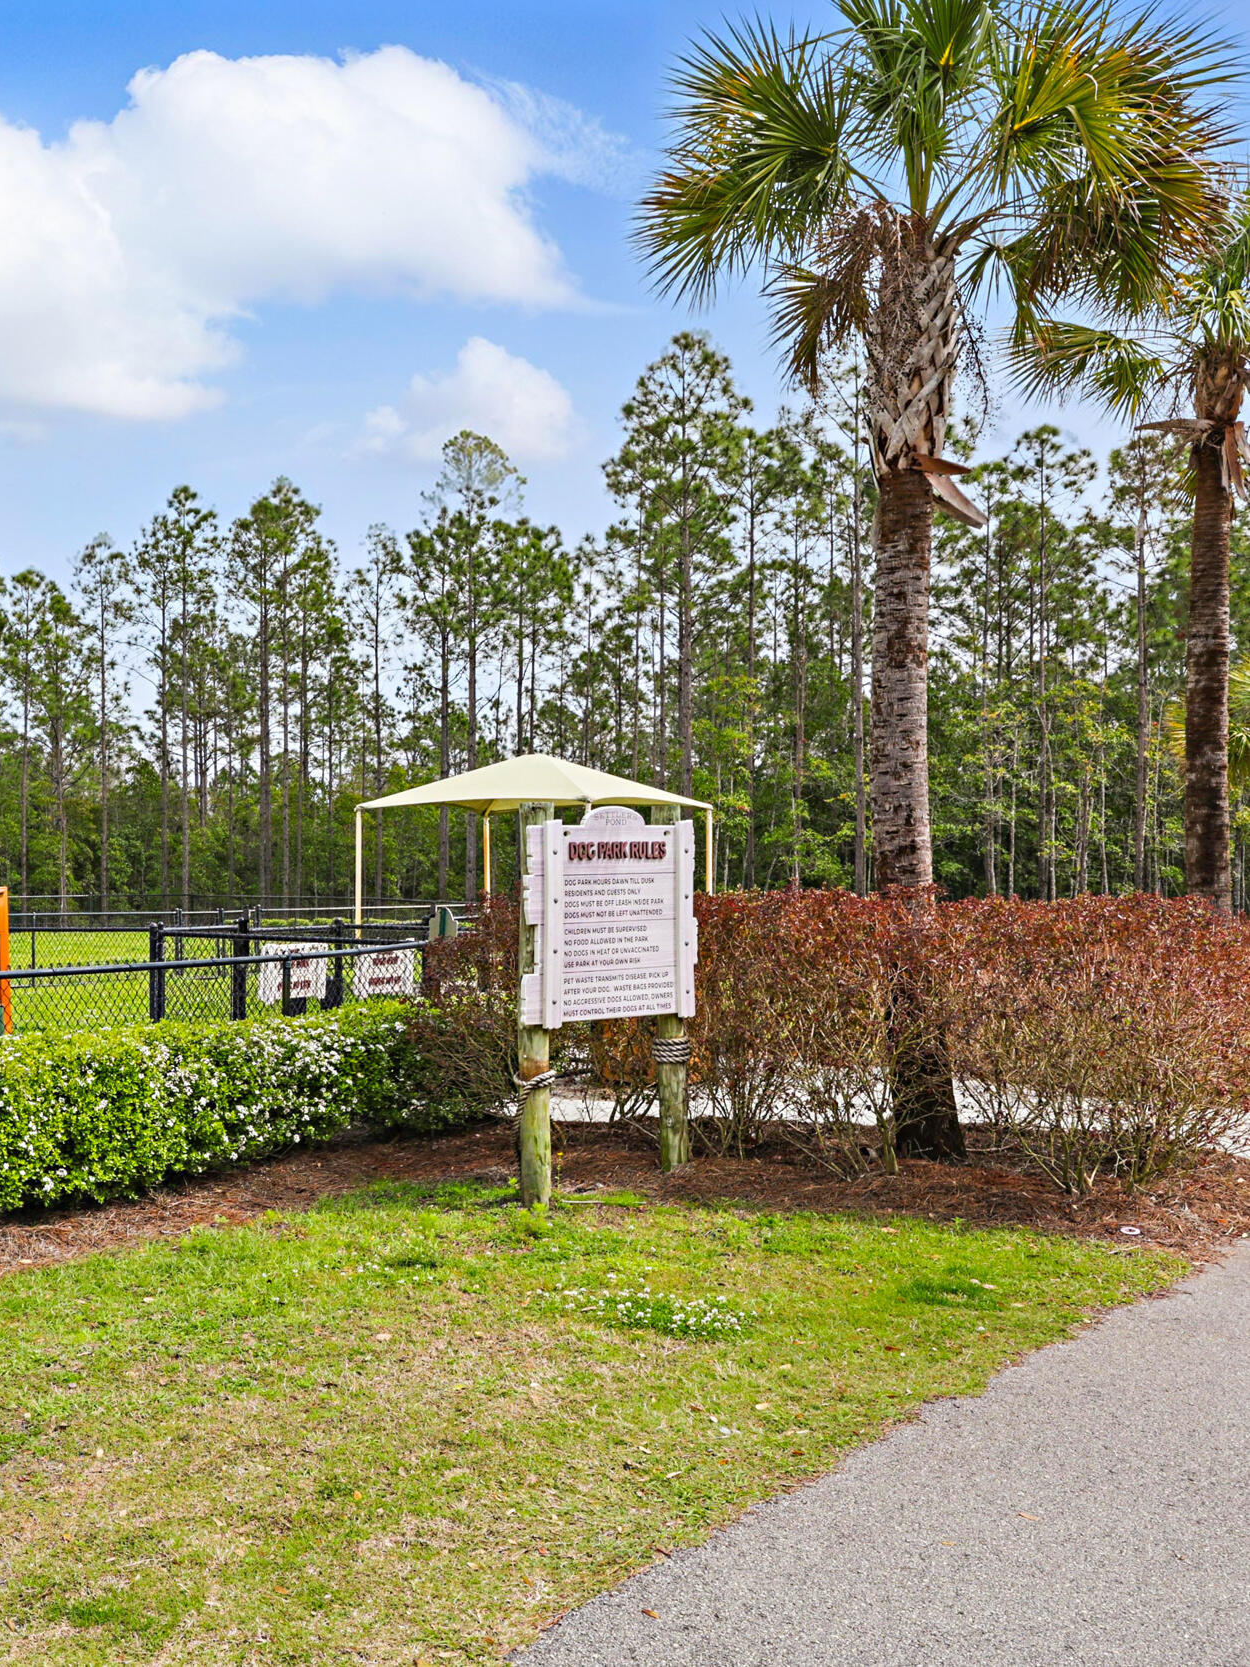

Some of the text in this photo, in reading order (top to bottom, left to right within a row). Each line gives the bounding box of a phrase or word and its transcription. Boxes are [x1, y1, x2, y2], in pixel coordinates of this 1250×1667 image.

[605, 818, 627, 826] POND
[568, 841, 667, 861] DOG PARK RULES
[564, 927, 591, 935] CHILDREN
[564, 939, 572, 947] NO
[590, 937, 616, 945] ALLOWED
[620, 945, 660, 954] UNVACCINATED
[564, 961, 575, 969] USE
[595, 974, 624, 982] TRANSMITS
[582, 986, 597, 994] YOUR
[573, 997, 606, 1005] AGGRESSIVE
[651, 992, 673, 1000] OWNERS
[563, 1009, 578, 1017] MUST
[579, 1008, 605, 1016] CONTROL
[606, 1006, 621, 1014] THEIR
[623, 1004, 637, 1012] DOGS
